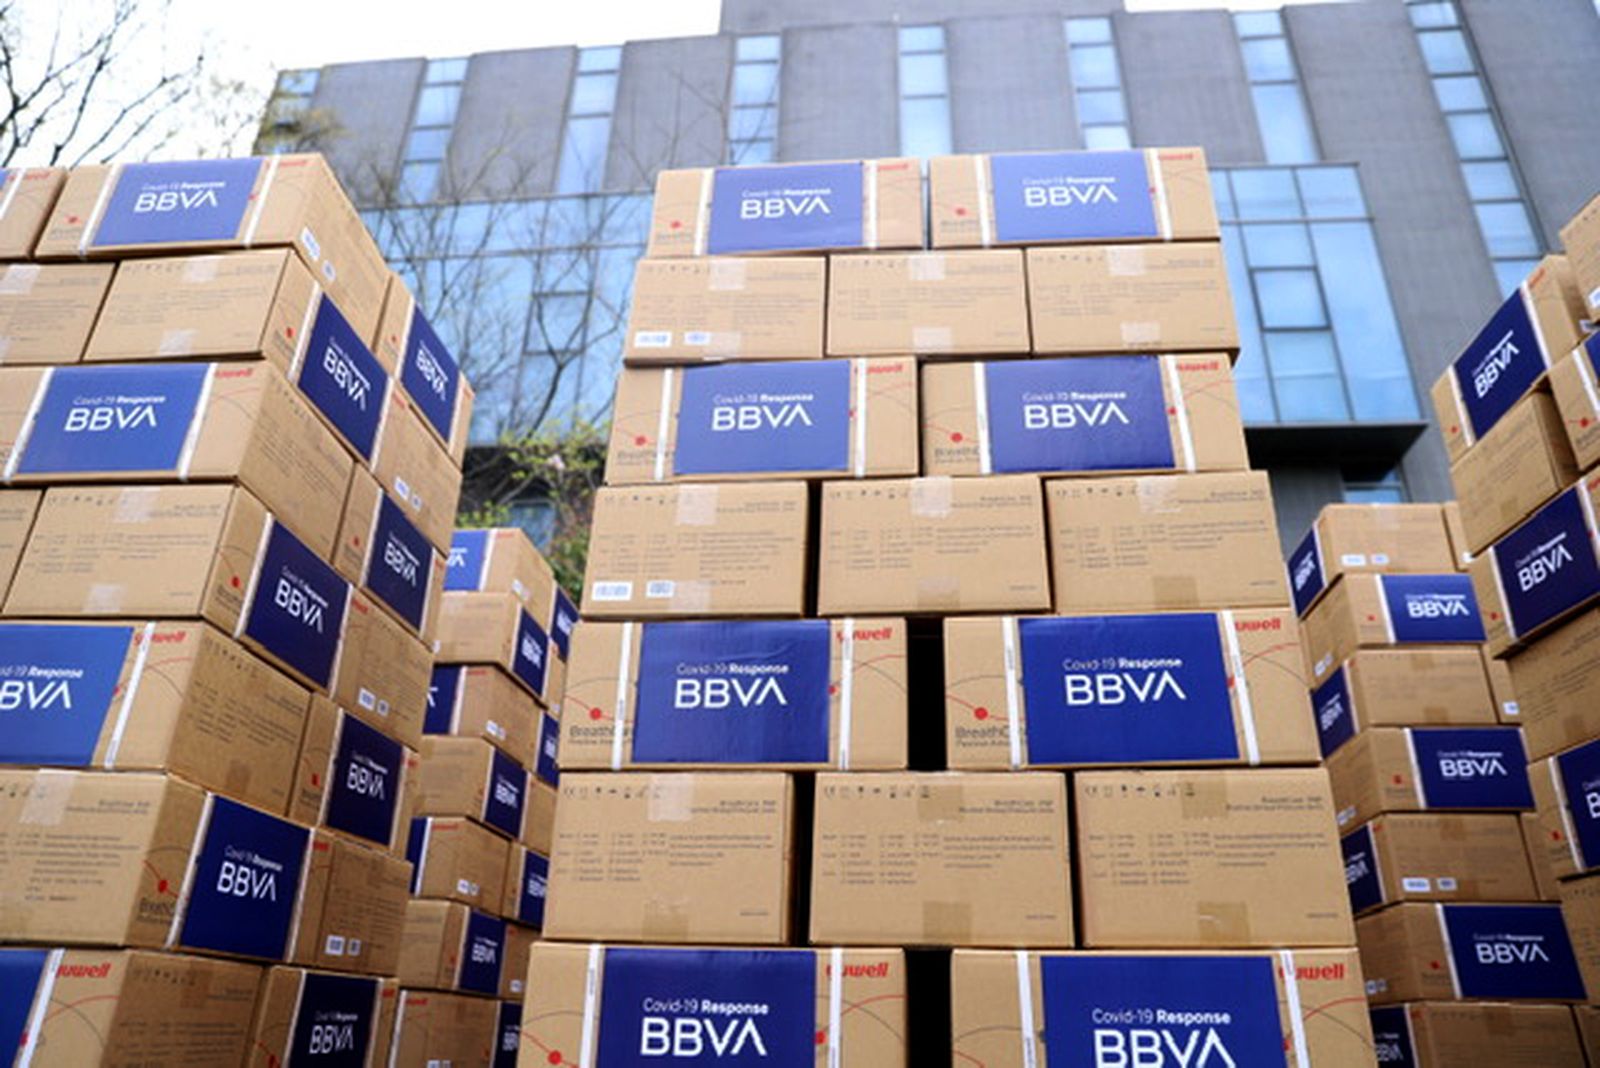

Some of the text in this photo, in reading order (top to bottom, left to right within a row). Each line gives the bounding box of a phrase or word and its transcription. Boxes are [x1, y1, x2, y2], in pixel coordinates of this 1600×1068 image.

[133, 190, 218, 213] BBVA
[741, 197, 831, 219] BBVA
[1024, 185, 1118, 207] BBVA
[323, 345, 366, 411] BBVA
[1474, 342, 1520, 399] BBVA
[760, 392, 814, 403] Response
[1071, 391, 1127, 401] Response
[64, 405, 157, 432] BBVA
[711, 403, 813, 431] BBVA
[1024, 402, 1129, 429] BBVA
[383, 541, 417, 588] BBVA
[1517, 544, 1573, 592] BBVA
[274, 578, 323, 633] BBVA
[1407, 600, 1470, 618] BBVA
[28, 665, 84, 679] Response
[676, 663, 789, 675] Covid-19 Response
[1063, 657, 1183, 671] Covid-19 Response
[0, 680, 72, 710] BVA
[674, 676, 787, 709] BBVA
[1064, 670, 1187, 705] BBVA
[1440, 758, 1508, 777] BBVA
[347, 763, 385, 800] BBVA
[217, 861, 277, 902] BBVA
[1475, 942, 1550, 965] BBVA
[55, 962, 112, 979] uwell
[643, 998, 769, 1017] Covid-19 Response
[1092, 1008, 1232, 1028] Covid-19 Response
[309, 1024, 354, 1055] BBVA
[640, 1017, 768, 1057] BBVA
[1093, 1028, 1236, 1068] BBVA
